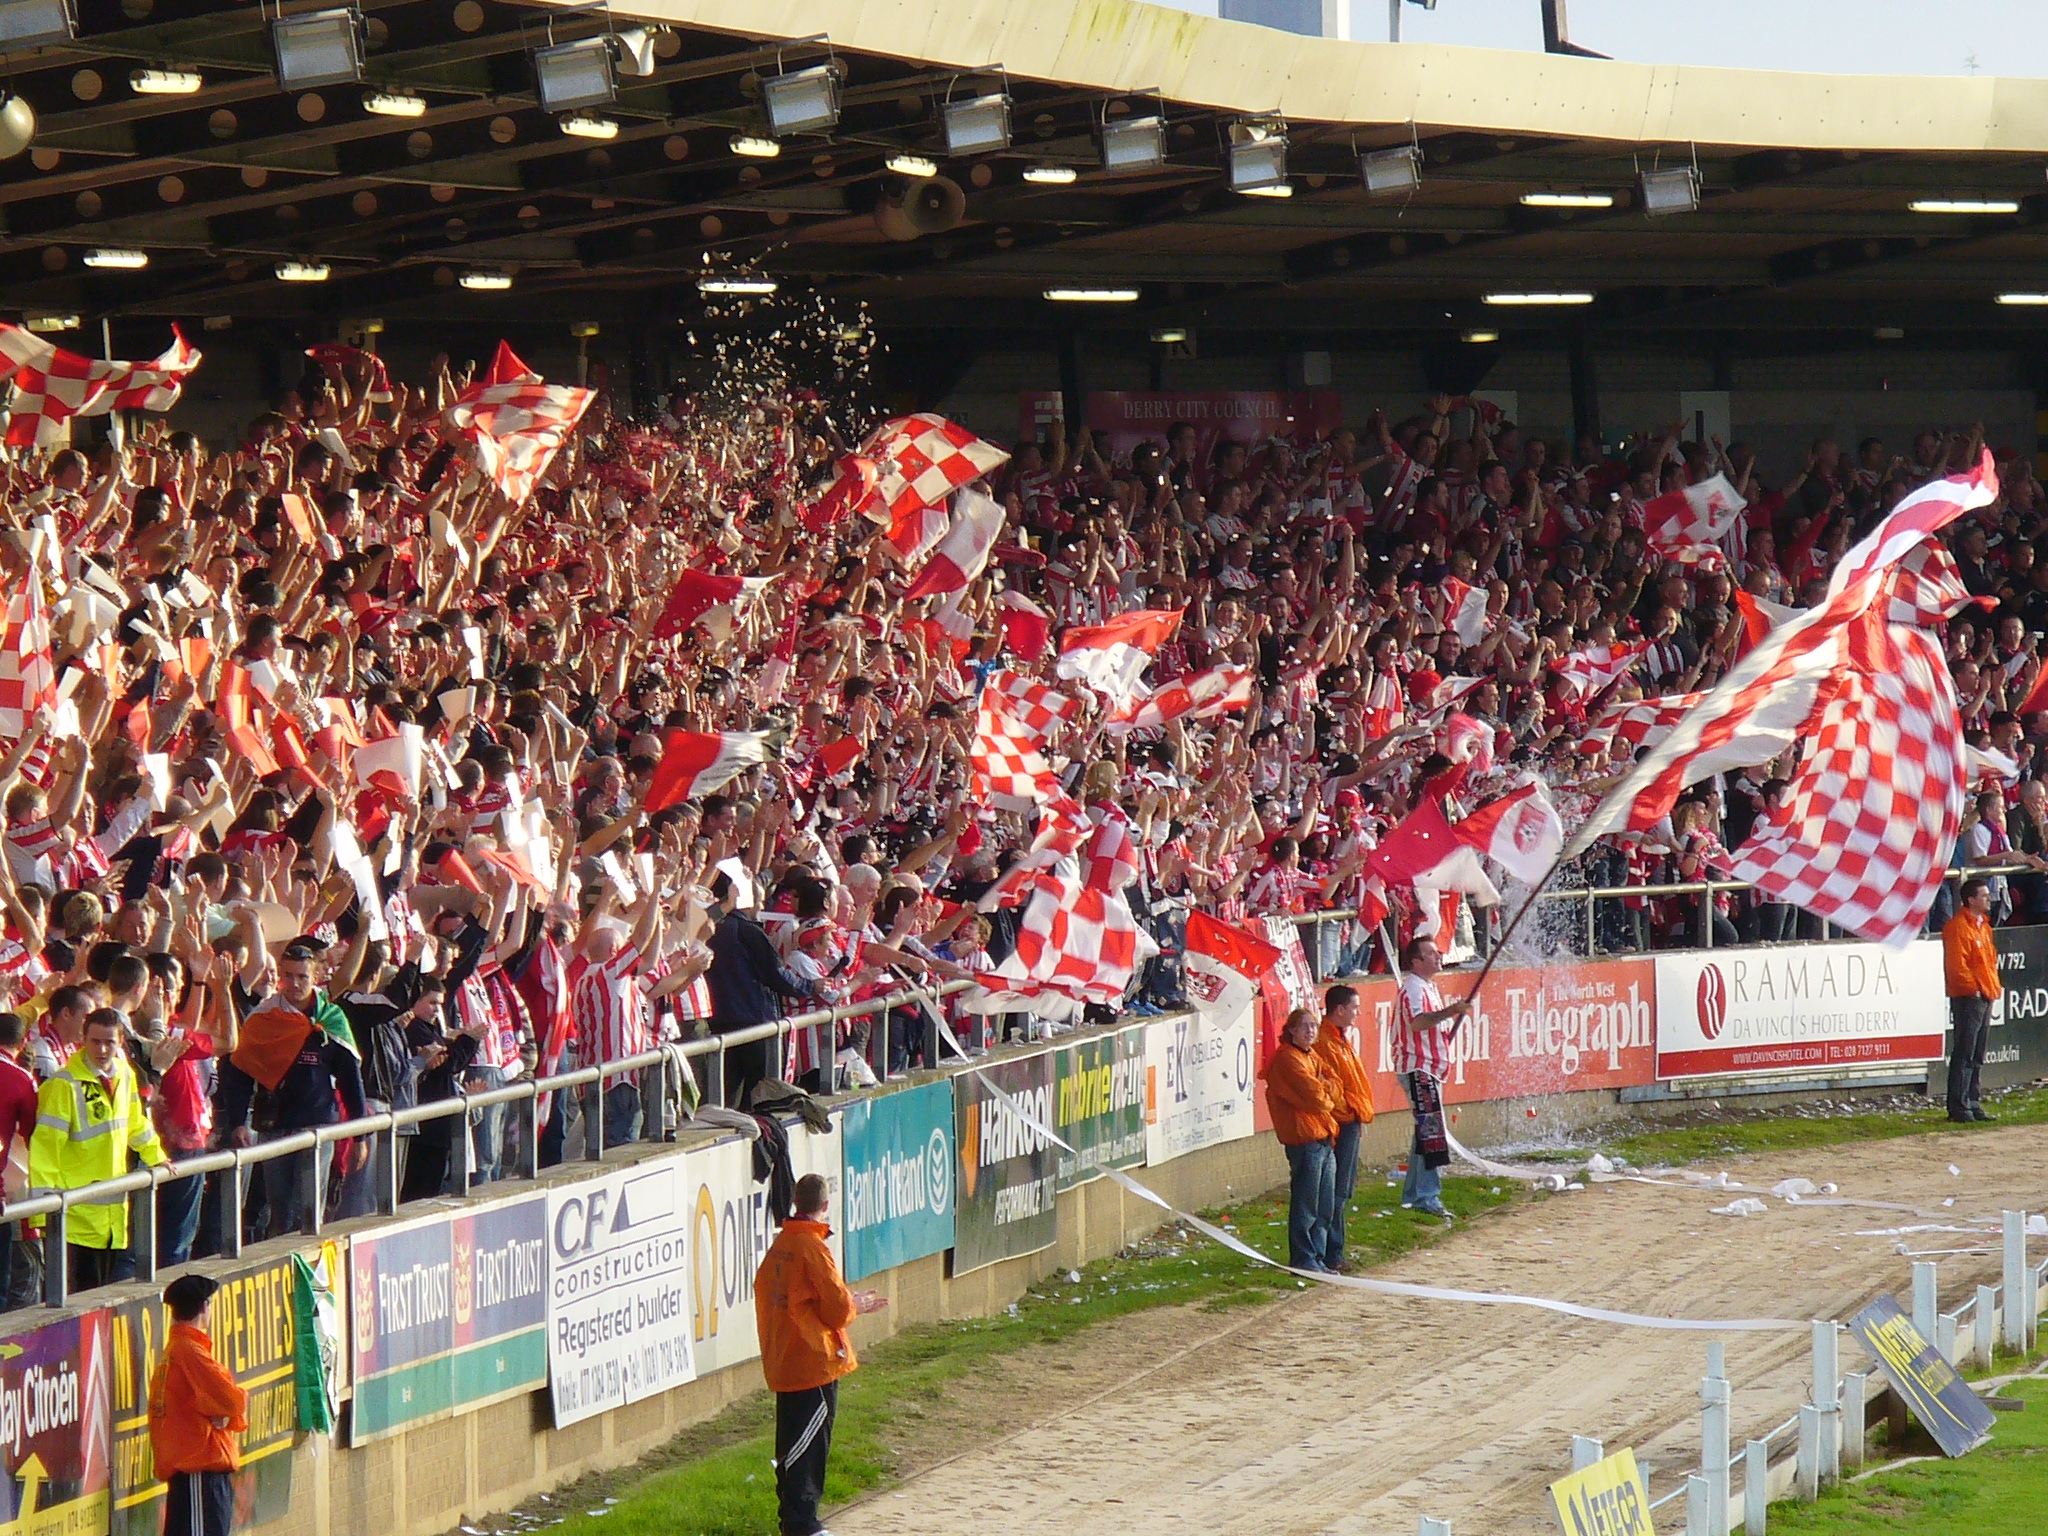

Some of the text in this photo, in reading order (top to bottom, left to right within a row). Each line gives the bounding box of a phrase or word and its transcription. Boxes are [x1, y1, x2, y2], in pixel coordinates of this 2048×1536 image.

[1123, 400, 1278, 419] DERRY CITY COUNCIL
[1595, 981, 1615, 999] West
[1733, 953, 1893, 1003] RAMADA
[2007, 952, 2025, 970] 792
[1505, 980, 1651, 1076] Telegraph
[1733, 1018, 1751, 1039] DA
[1811, 1013, 1851, 1034] HOTEL
[1855, 1011, 1899, 1032] DERRY
[847, 1145, 925, 1232] Bank of Ireland
[555, 1236, 685, 1298] construction
[722, 1190, 777, 1309] OME
[558, 1285, 682, 1358] Registered builder
[23, 1360, 79, 1438] Citroën
